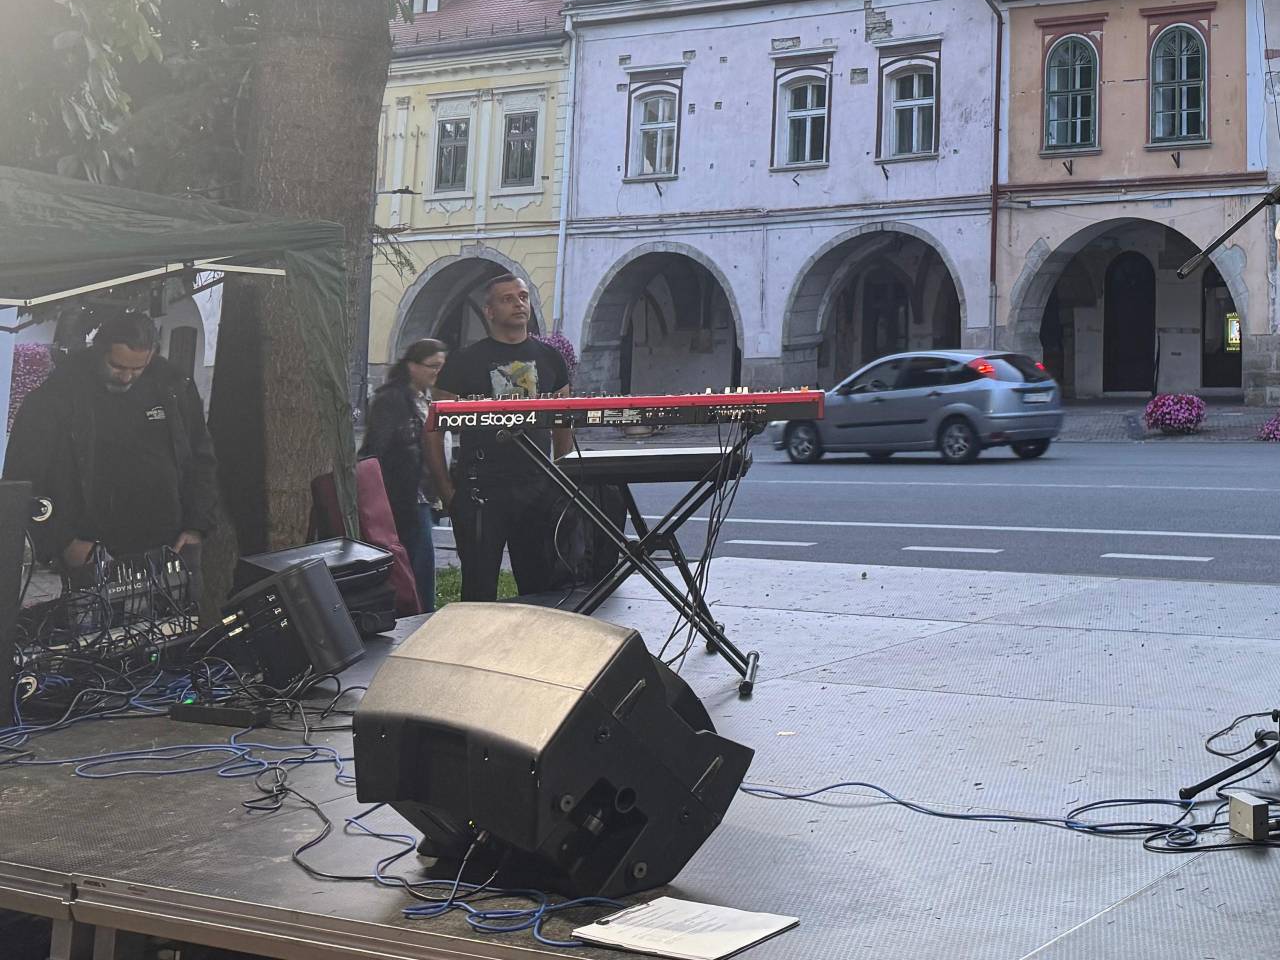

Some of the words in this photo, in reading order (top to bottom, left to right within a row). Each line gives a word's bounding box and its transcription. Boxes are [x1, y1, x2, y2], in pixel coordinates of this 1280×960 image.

[438, 412, 477, 427] nord
[480, 412, 524, 428] stage
[526, 411, 537, 424] 4
